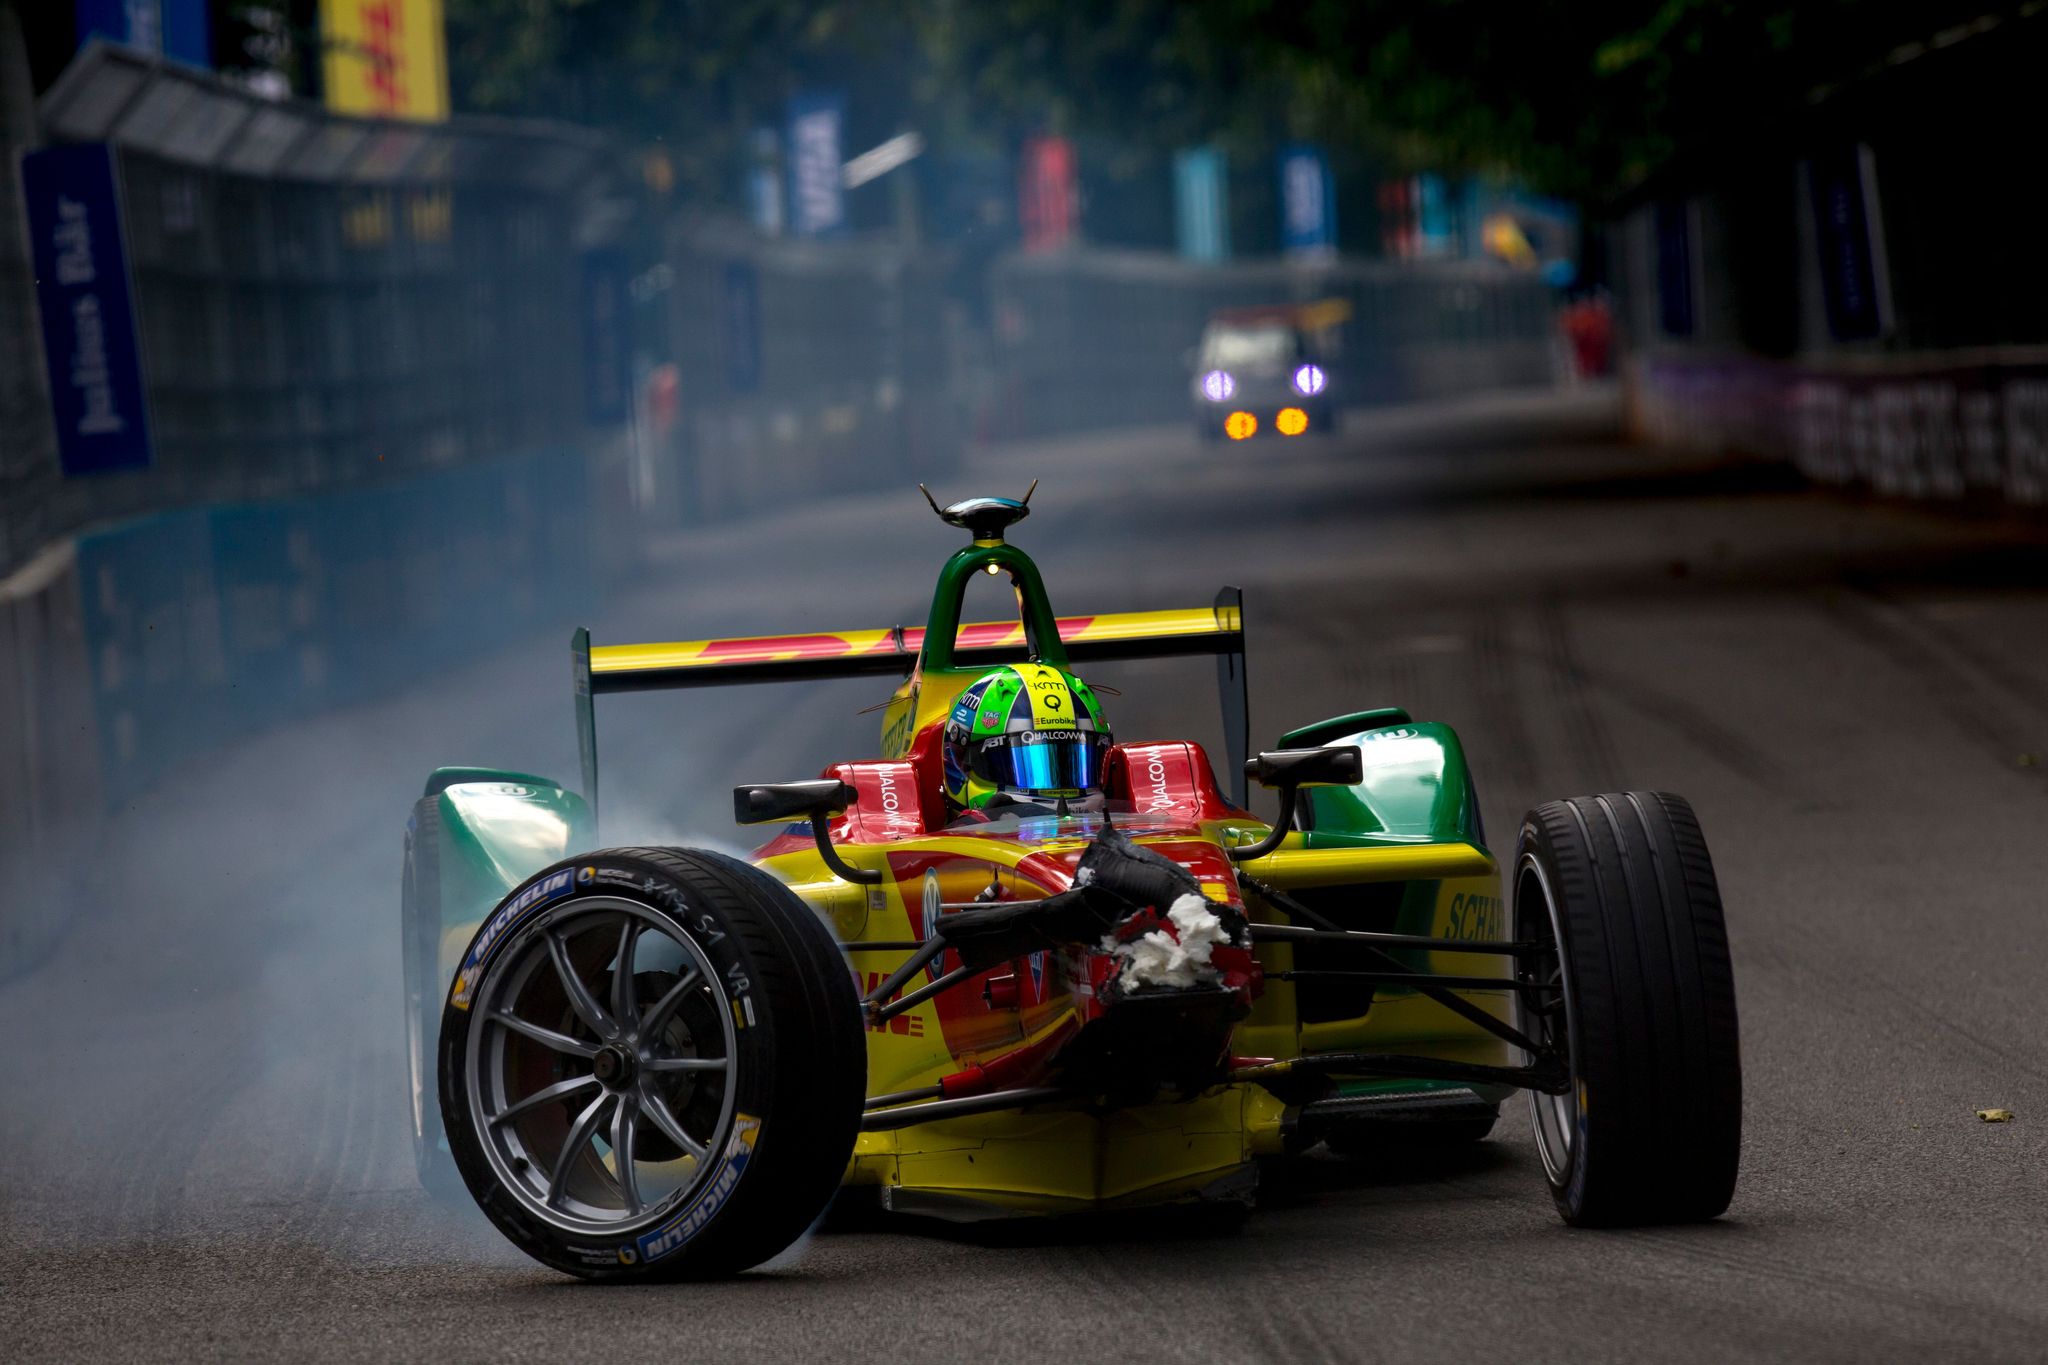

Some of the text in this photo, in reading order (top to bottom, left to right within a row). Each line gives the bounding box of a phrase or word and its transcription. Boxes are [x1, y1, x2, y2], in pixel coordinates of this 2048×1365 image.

[984, 711, 1000, 719] TAG
[1041, 717, 1076, 725] Eurobike
[981, 735, 1007, 753] ABT
[474, 873, 569, 960] MICHELIN
[648, 1163, 738, 1257] MICHELIN
